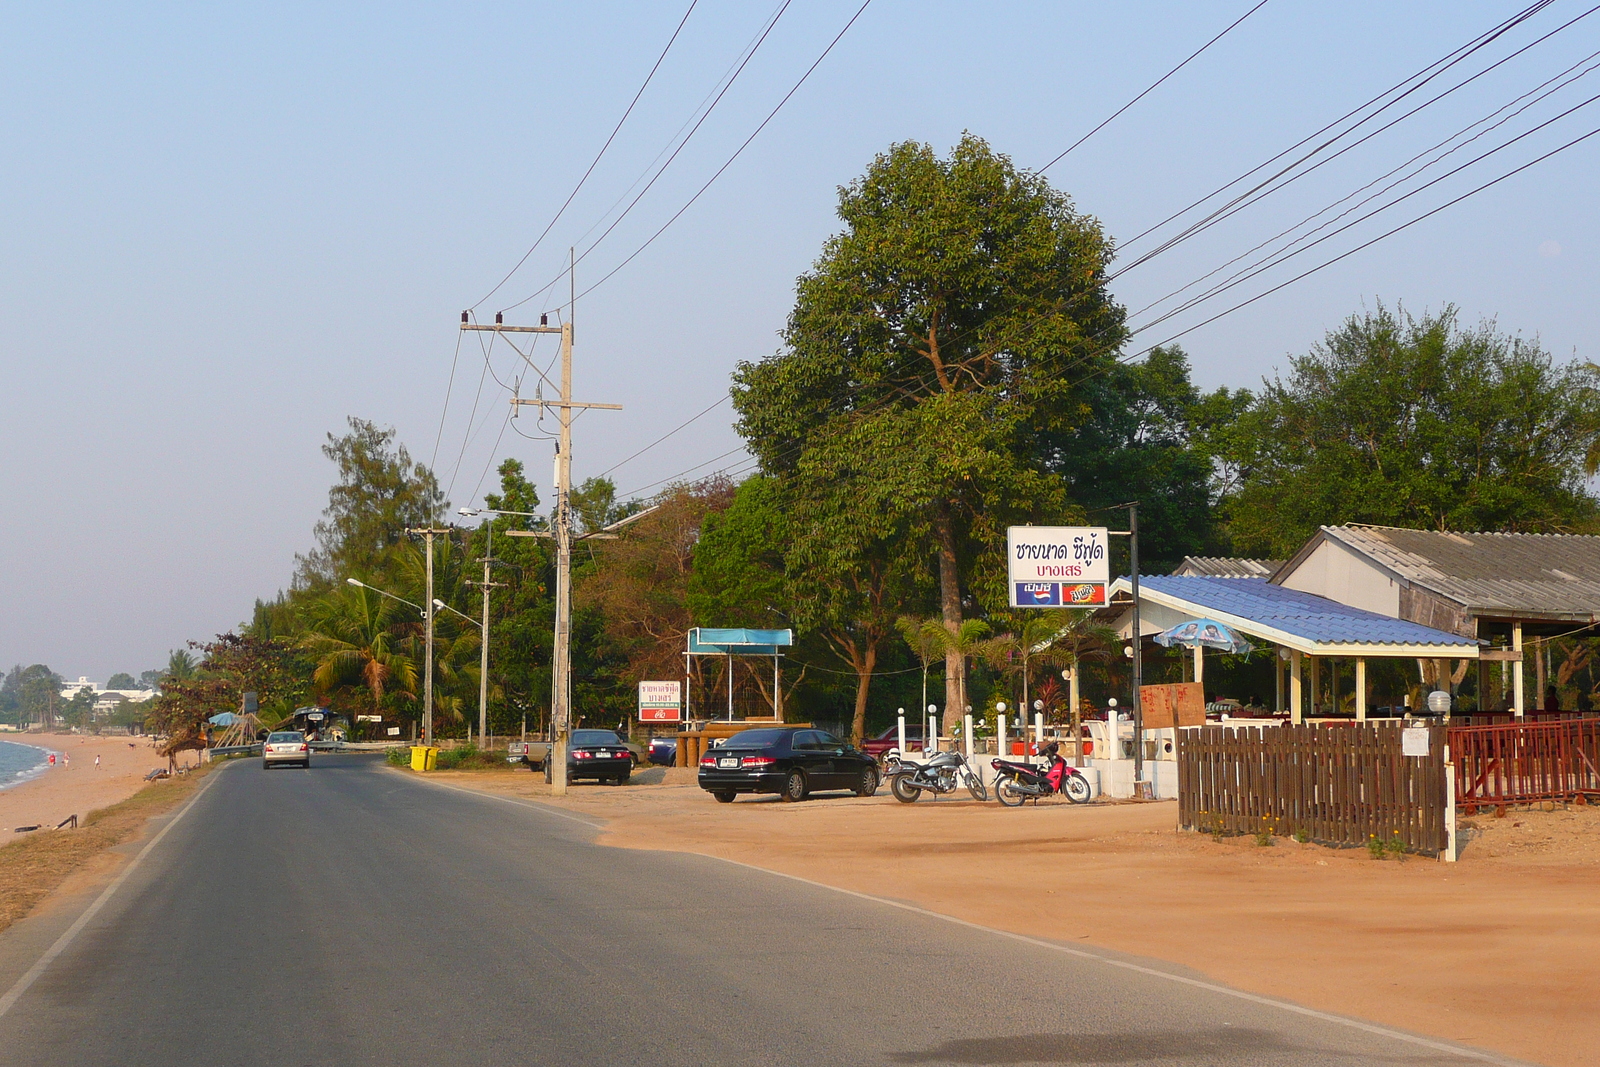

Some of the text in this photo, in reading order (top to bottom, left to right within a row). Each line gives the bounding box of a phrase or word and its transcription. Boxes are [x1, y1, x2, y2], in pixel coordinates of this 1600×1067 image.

[1016, 533, 1104, 567] ชายหาด ซีฟู้ด
[1037, 562, 1082, 577] บางเสร่
